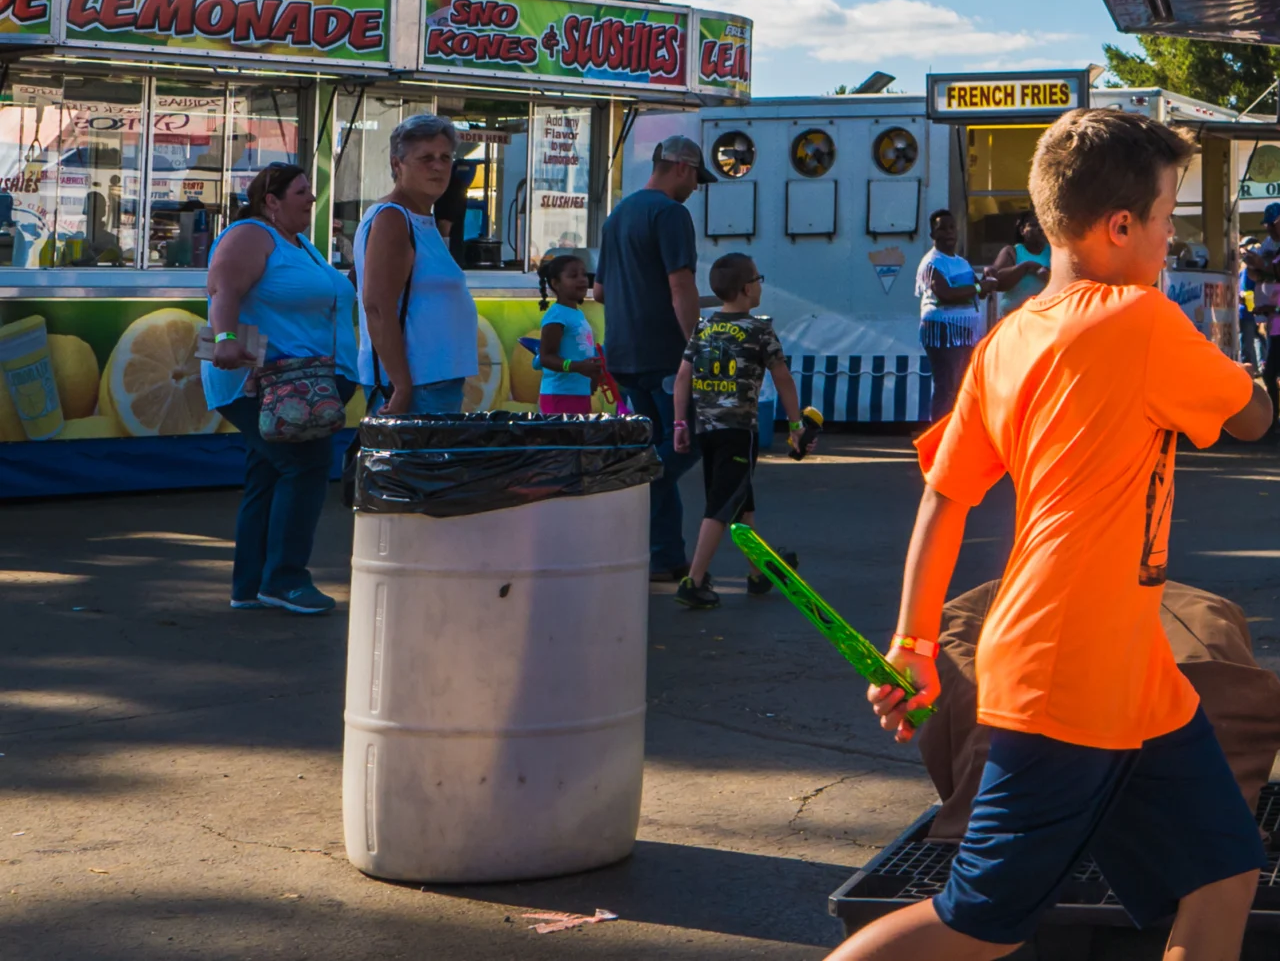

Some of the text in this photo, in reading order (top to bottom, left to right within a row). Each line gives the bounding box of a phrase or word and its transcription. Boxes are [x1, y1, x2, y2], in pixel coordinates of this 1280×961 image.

[426, 27, 538, 65] KONES
[561, 14, 680, 78] SLUSHIES
[947, 82, 1071, 109] FRENCH FRIES
[544, 113, 563, 127] Add
[544, 128, 579, 140] Flavor
[540, 195, 585, 209] SLUSHIES
[698, 322, 746, 342] TRACTOR
[692, 379, 737, 392] FACTOR
